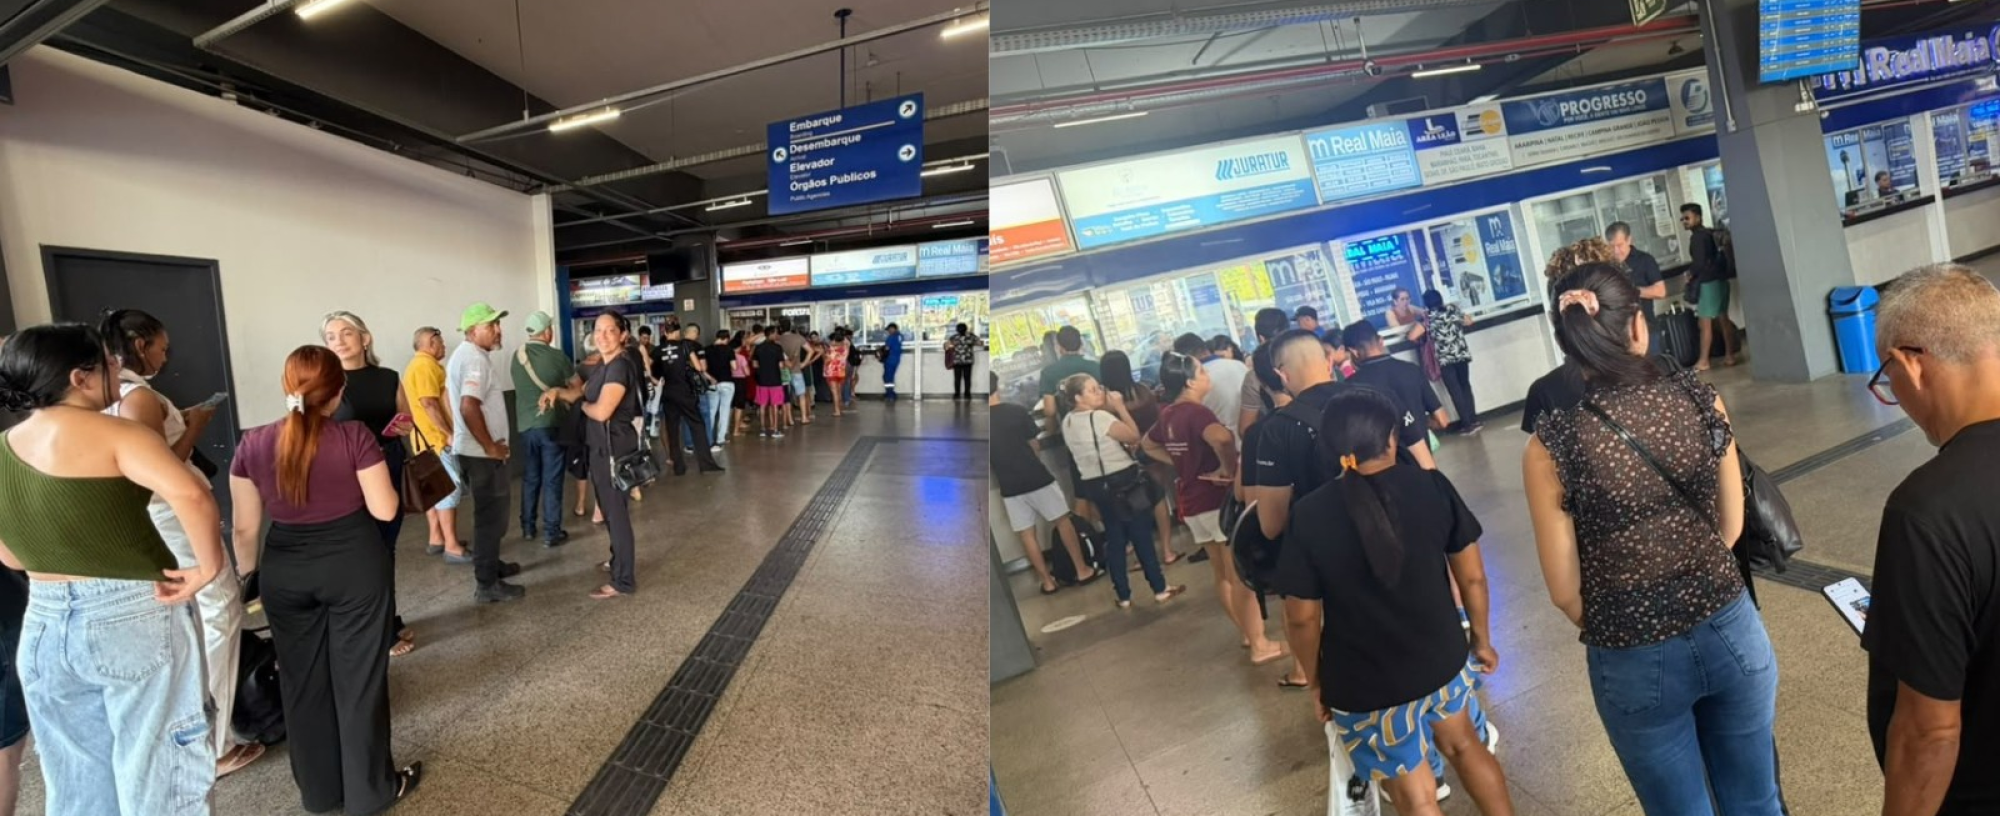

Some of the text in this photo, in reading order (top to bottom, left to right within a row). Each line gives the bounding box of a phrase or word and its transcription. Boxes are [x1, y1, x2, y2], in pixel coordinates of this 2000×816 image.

[1560, 89, 1647, 117] PROGRESSO
[790, 114, 842, 132] Embarque
[790, 134, 862, 154] Desembarque
[1330, 132, 1367, 156] Real
[1369, 127, 1407, 150] Maia
[790, 158, 836, 173] Elevador
[1234, 151, 1289, 175] JURATUR
[931, 244, 951, 256] Real
[952, 243, 975, 255] Maia
